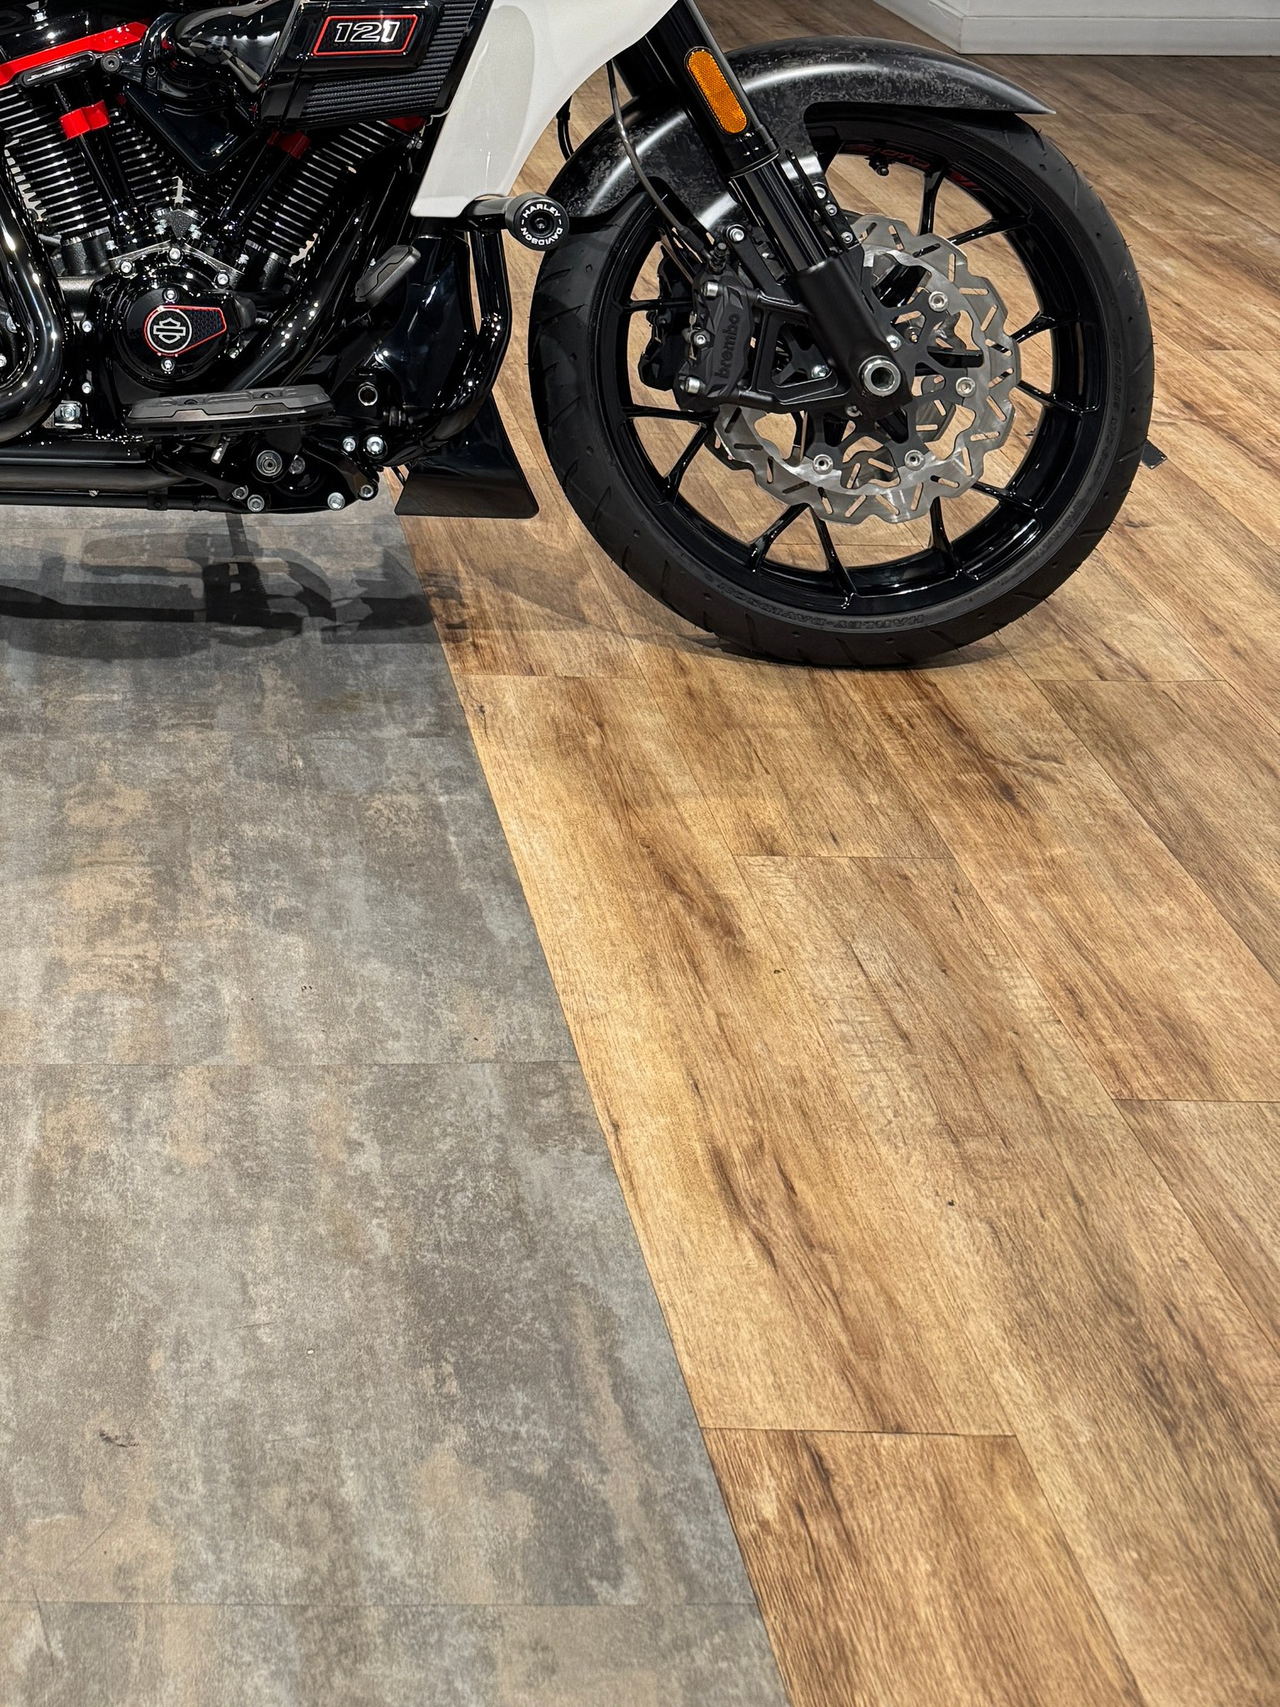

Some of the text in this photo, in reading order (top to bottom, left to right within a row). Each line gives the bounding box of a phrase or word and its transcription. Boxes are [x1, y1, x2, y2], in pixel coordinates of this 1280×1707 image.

[334, 20, 400, 43] 121
[522, 203, 561, 219] HARLEY
[521, 227, 563, 246] DAVIDSON
[714, 314, 741, 379] brembo
